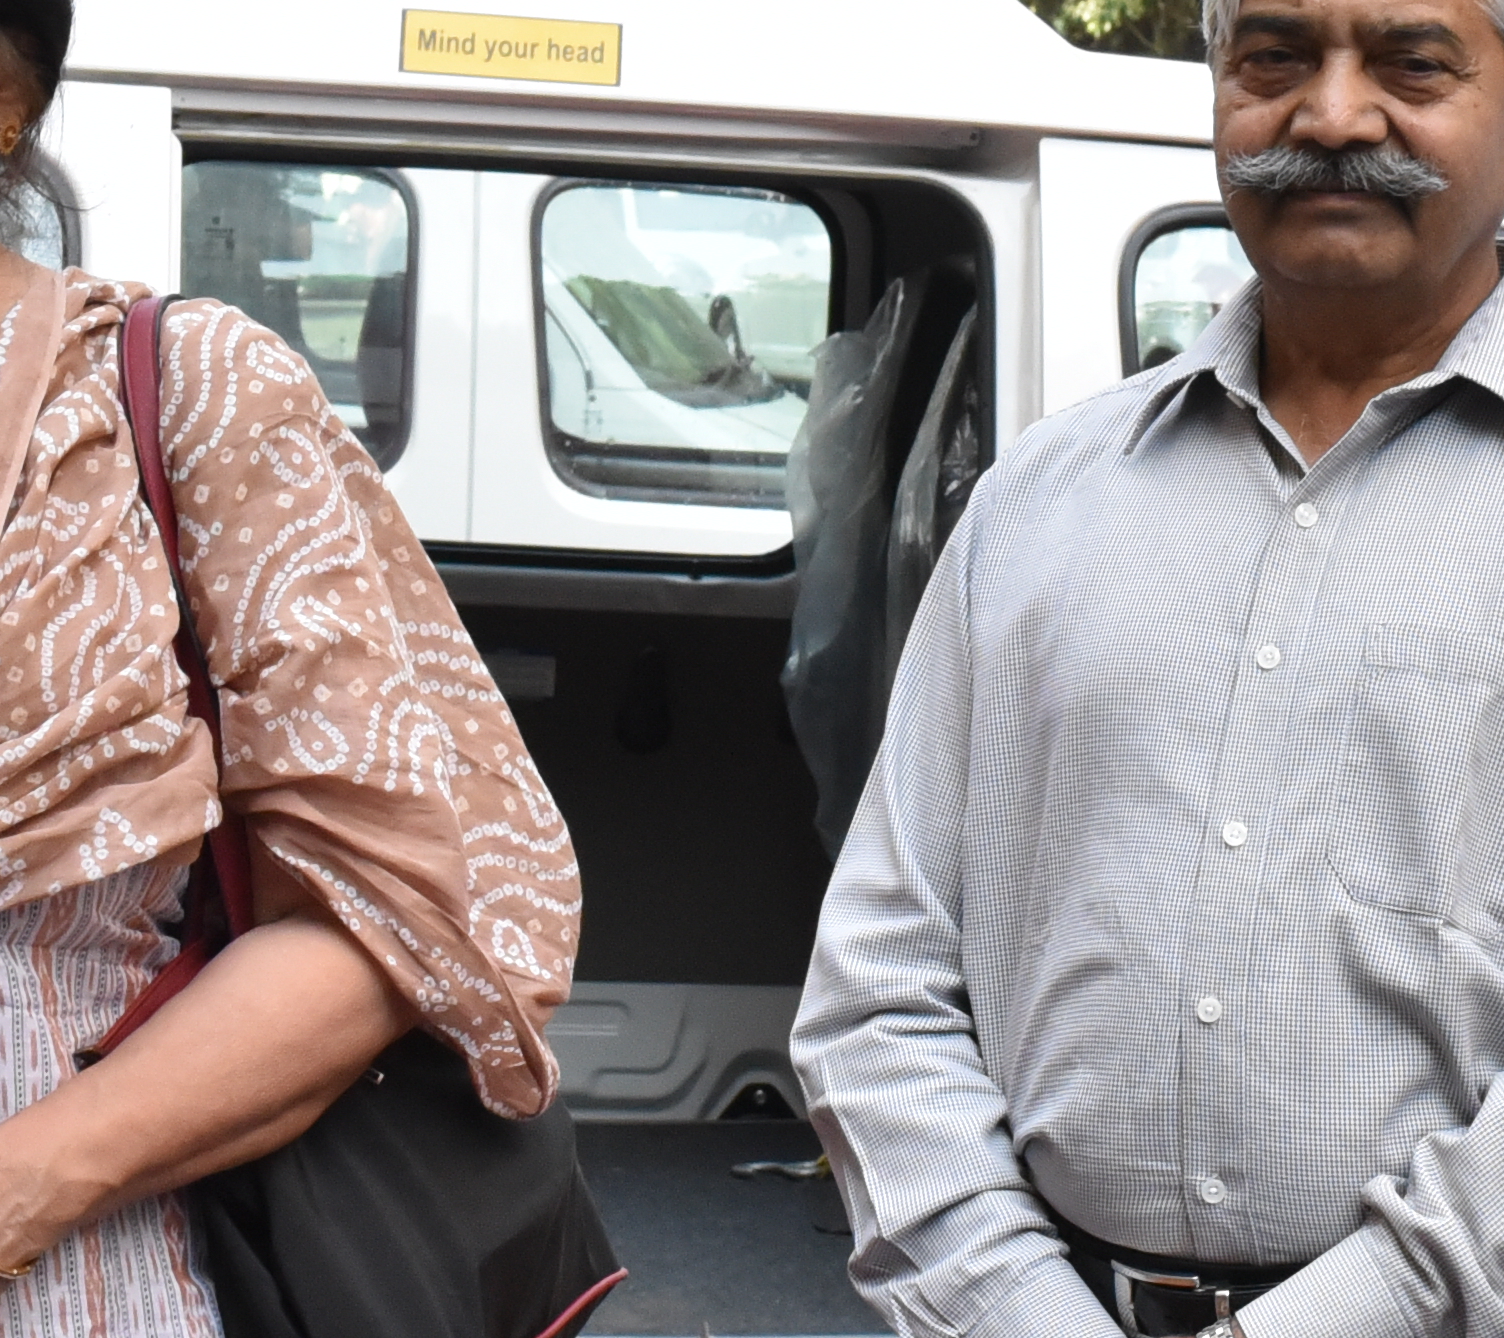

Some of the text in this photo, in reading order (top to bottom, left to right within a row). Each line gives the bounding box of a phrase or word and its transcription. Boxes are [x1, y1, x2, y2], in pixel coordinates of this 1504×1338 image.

[417, 28, 606, 64] Mind your head
